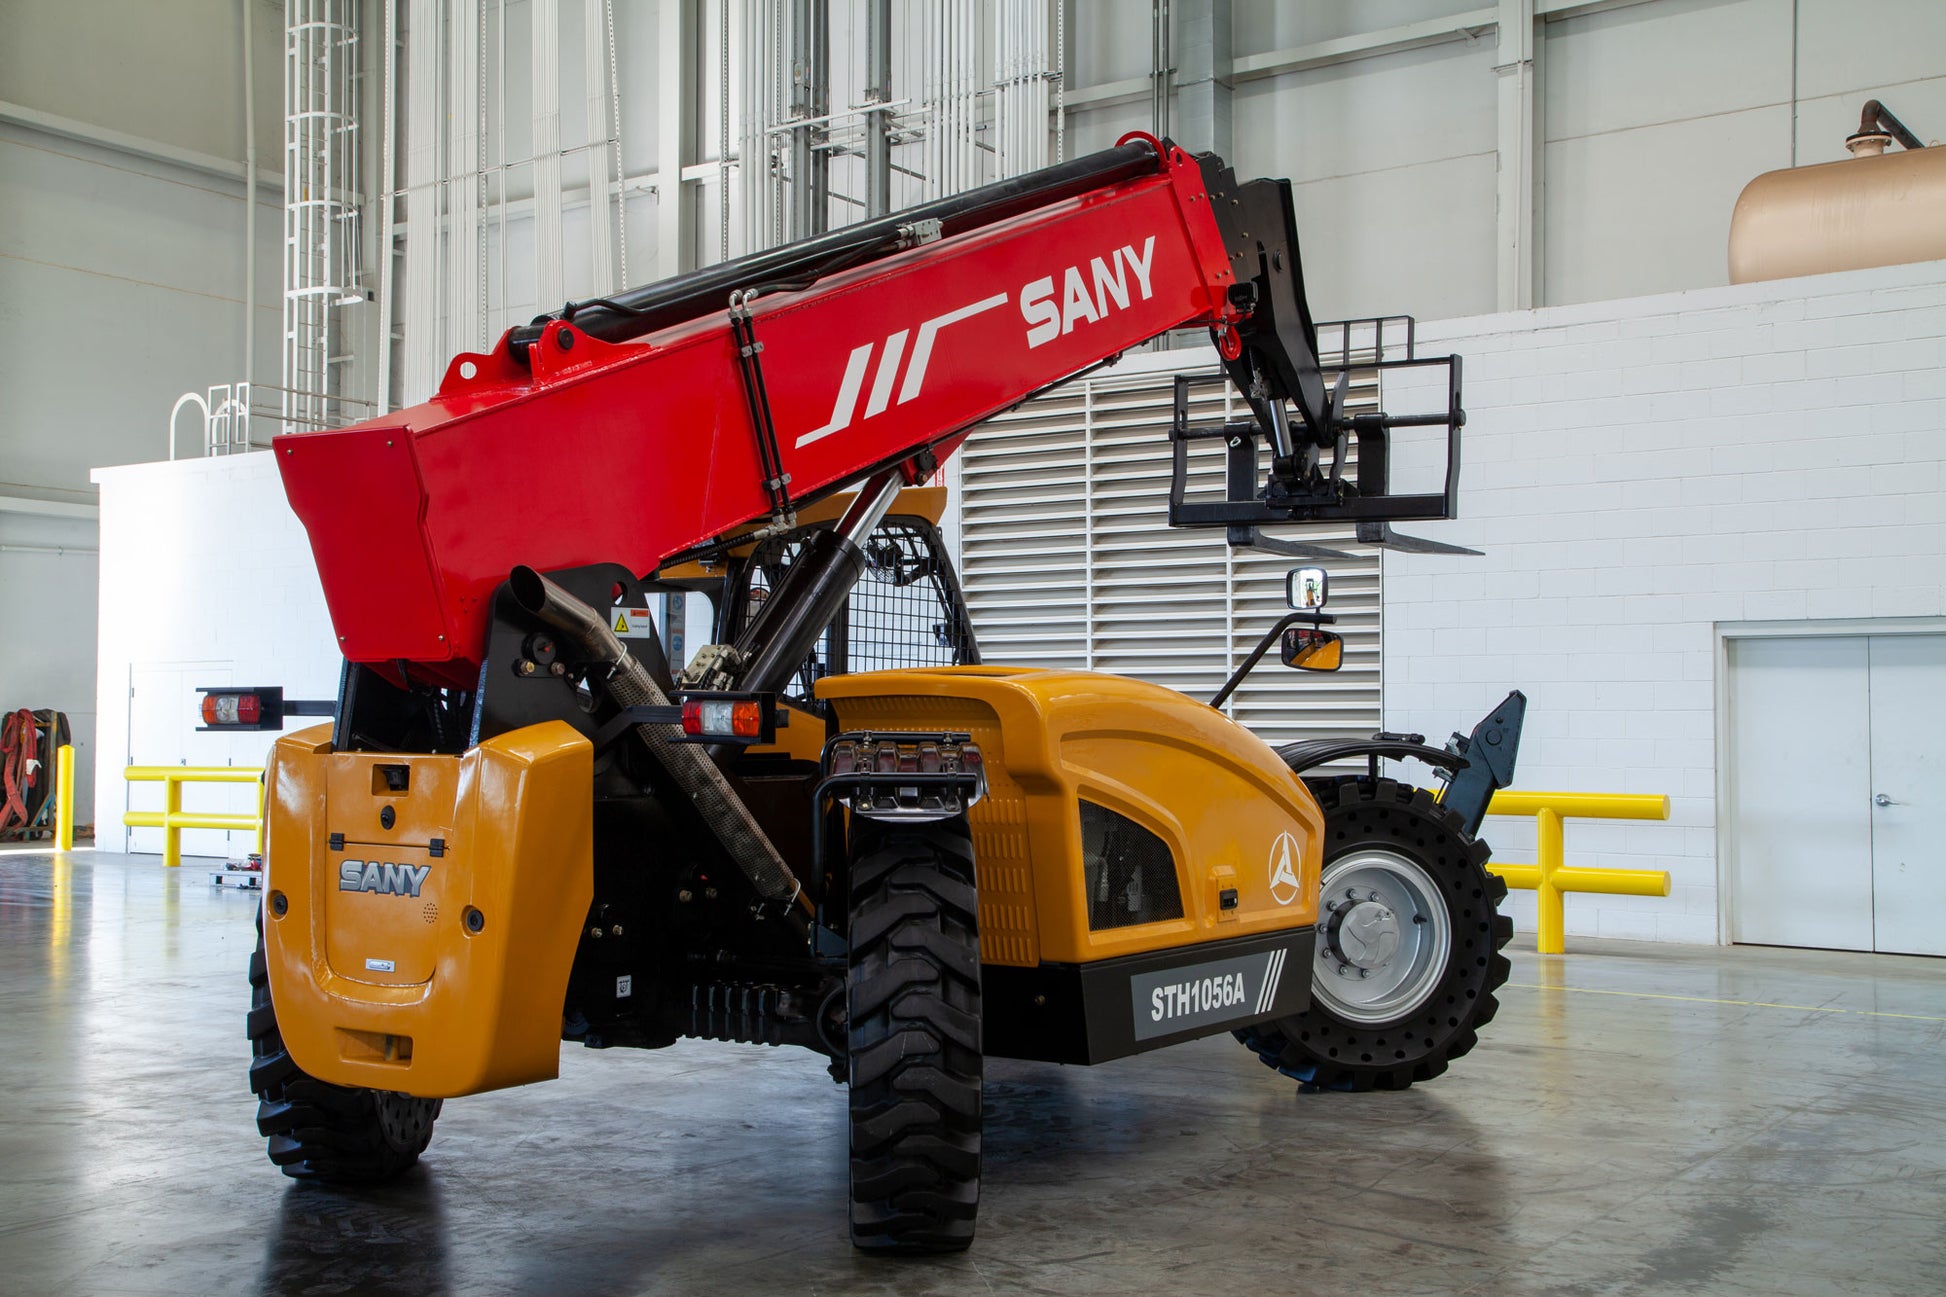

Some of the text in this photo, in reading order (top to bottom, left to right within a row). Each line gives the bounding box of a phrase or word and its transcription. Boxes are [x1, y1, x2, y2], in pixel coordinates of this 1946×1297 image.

[1020, 235, 1155, 349] SANY
[339, 860, 431, 897] SANY
[1151, 972, 1245, 1022] STH1056A
